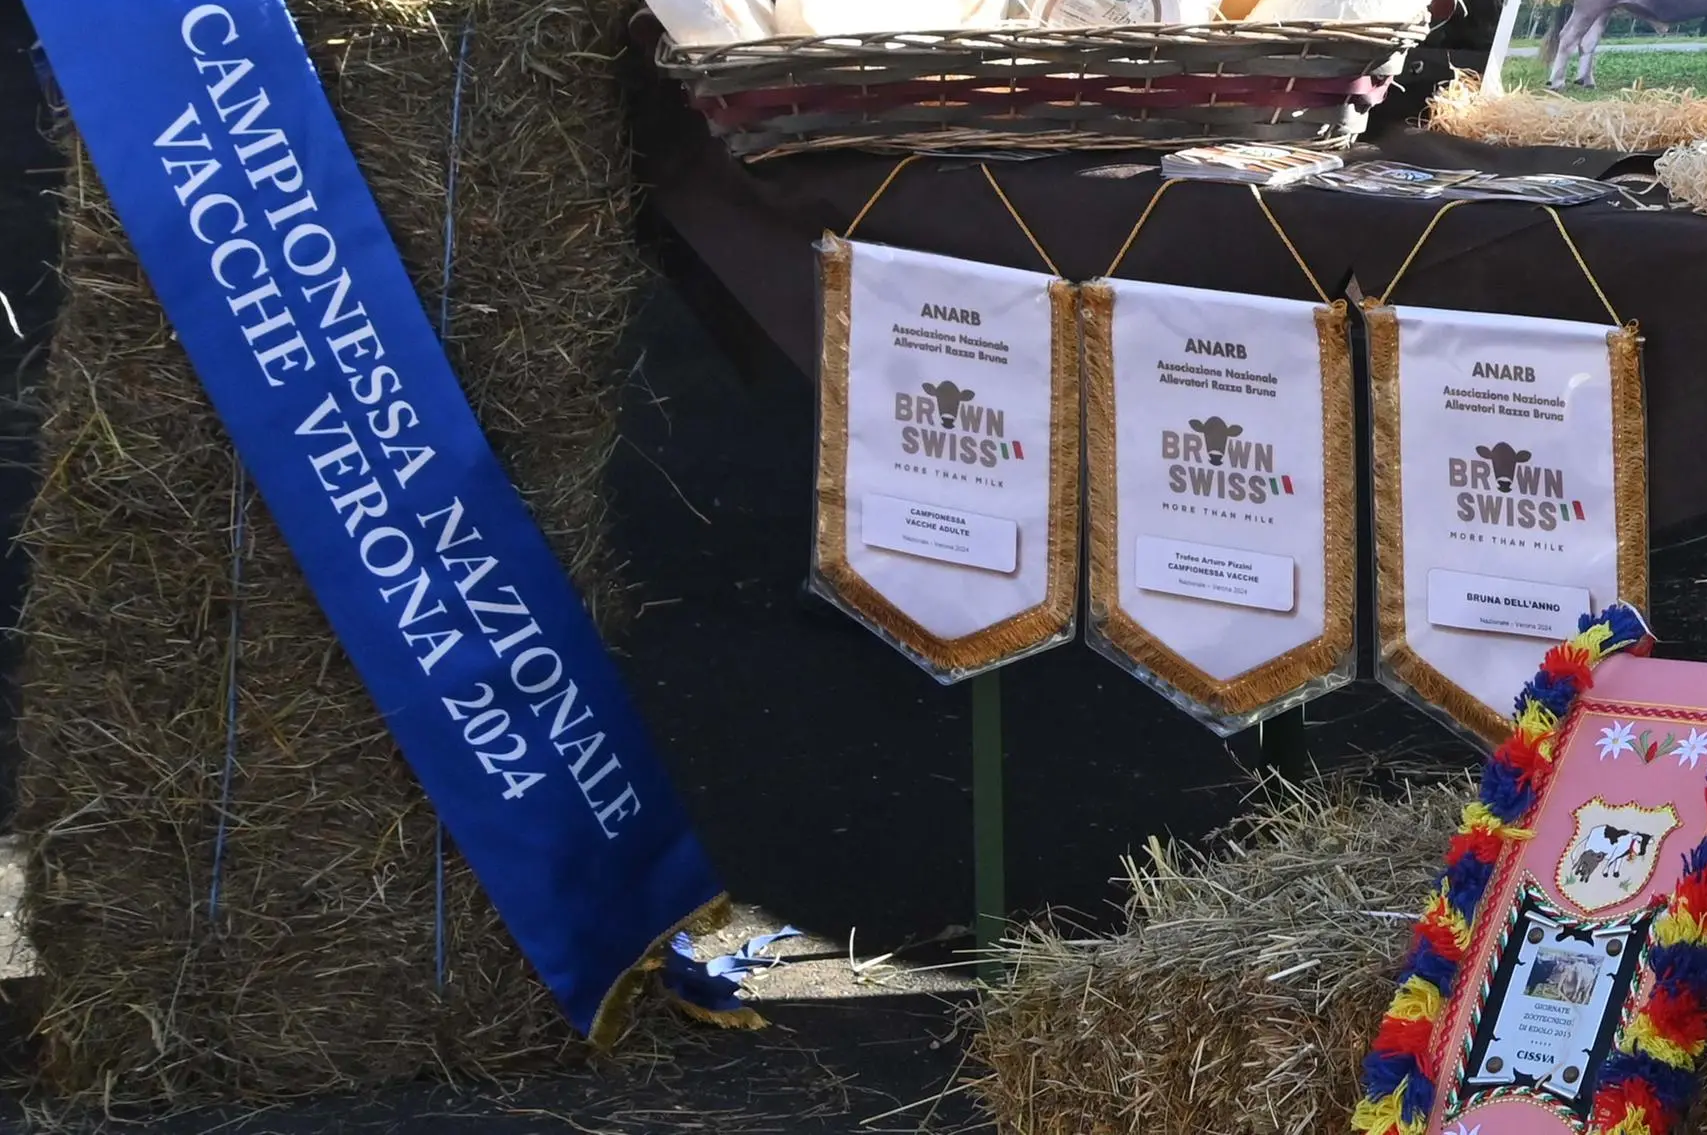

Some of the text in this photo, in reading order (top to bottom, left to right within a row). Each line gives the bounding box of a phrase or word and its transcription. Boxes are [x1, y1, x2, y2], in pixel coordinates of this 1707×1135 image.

[921, 302, 981, 326] ANARB
[892, 323, 1009, 352] Associazione Nazionale
[1185, 338, 1247, 360] ANARB
[894, 337, 1008, 364] Allevatori Razza Bruna
[1157, 360, 1278, 385] Associazione Nazionale
[1472, 361, 1536, 383] ANARB
[1159, 374, 1276, 397] Allevatori Razza Bruna
[1443, 385, 1566, 408] Associazione Nazionale
[180, 3, 642, 840] CAMPIONESSA NAZIONALE
[1445, 399, 1564, 422] Allevatori Razza Bruna
[153, 102, 548, 800] VACCHE VERONA 2024
[902, 425, 997, 468] SWISS
[895, 463, 1004, 488] MORE THAN MILK
[1169, 464, 1266, 504] SWISS
[910, 508, 966, 525] CAMPIONESSA
[1162, 502, 1274, 525] MORE THAN MILK
[1457, 492, 1557, 531] SWISS
[905, 517, 970, 537] VACCHE ADULTE
[1450, 531, 1564, 552] MORE THAN MILK
[1175, 552, 1200, 563] Trofeo
[1201, 556, 1226, 567] Arturo
[1168, 563, 1259, 583] CAMPIONESSA VACCHE
[1466, 592, 1560, 613] BRUNA DELL'ANNO
[1534, 1003, 1571, 1014] GIORNATE
[1518, 1023, 1527, 1032] DI
[1528, 1024, 1553, 1036] EDOLO
[1516, 1050, 1556, 1065] CISSVA
